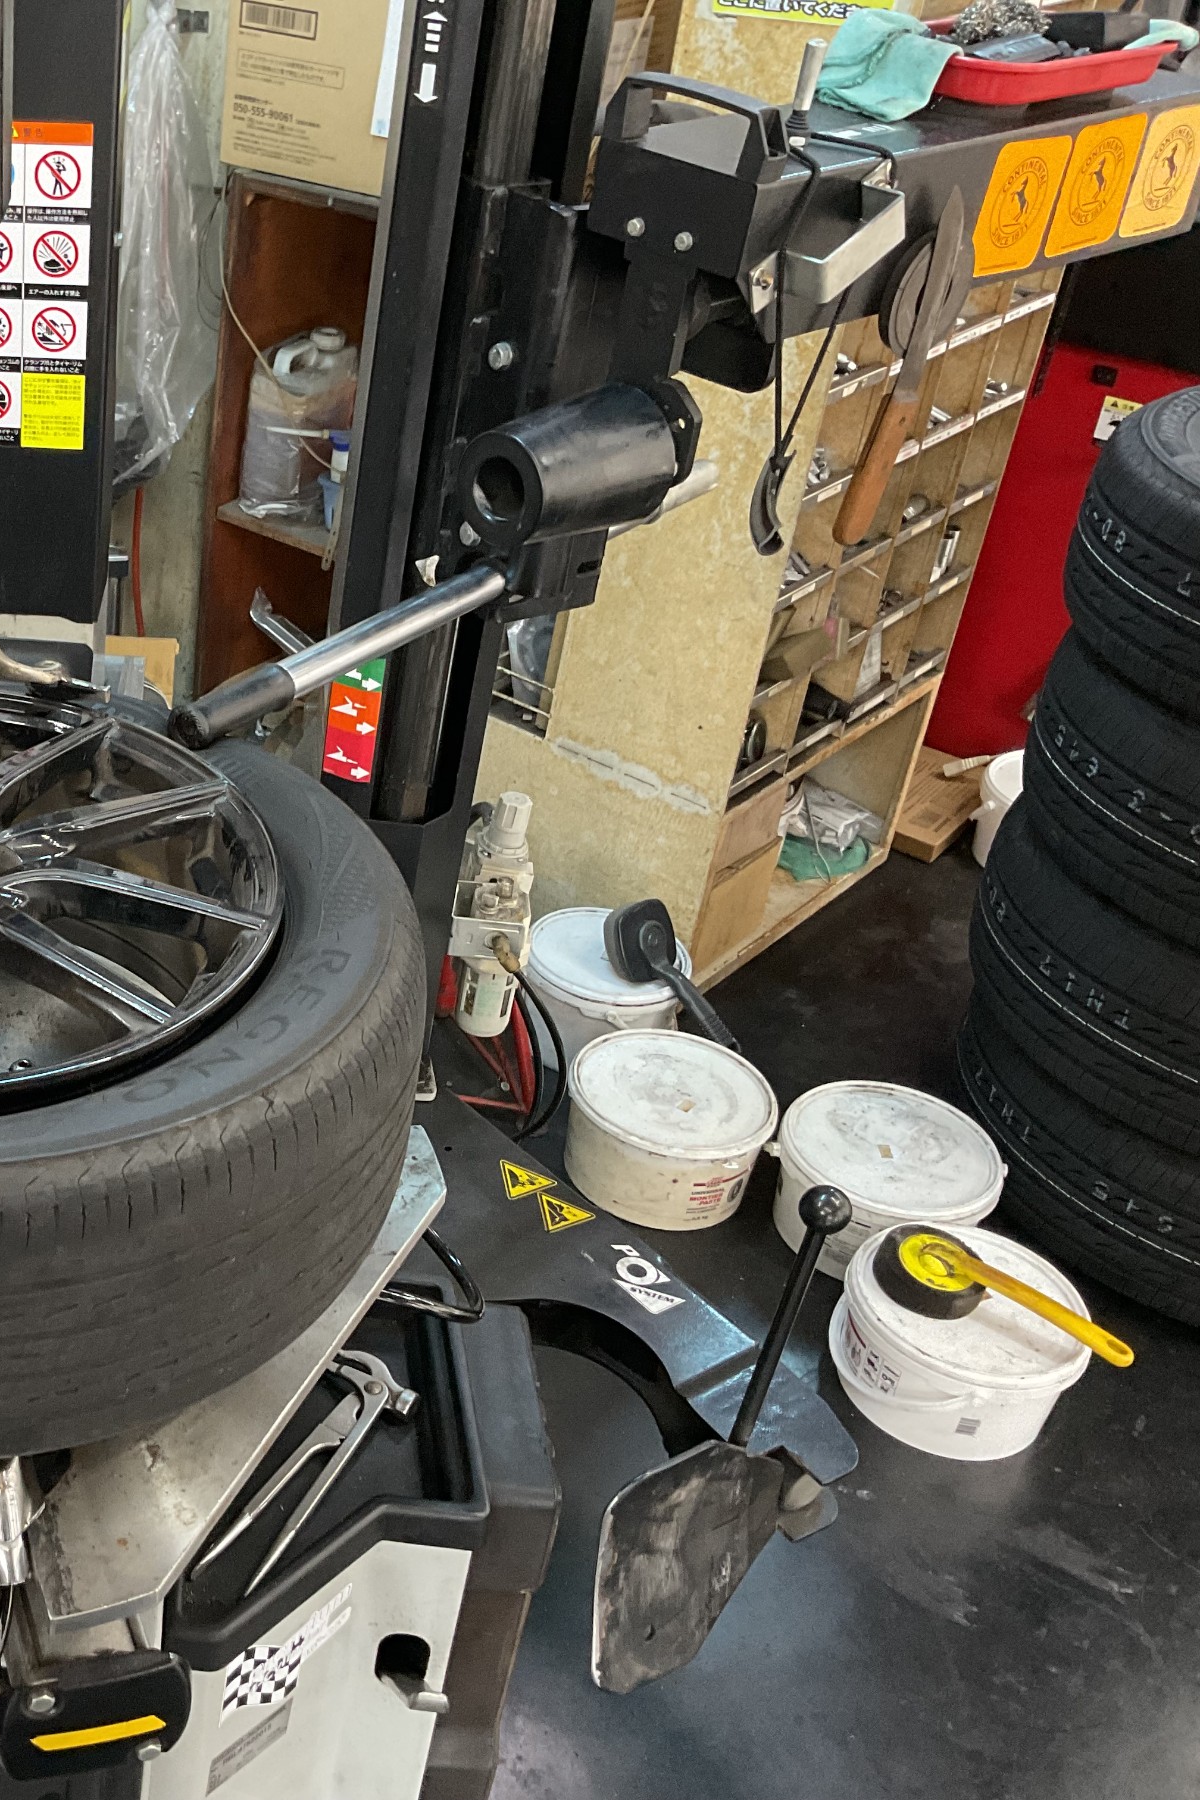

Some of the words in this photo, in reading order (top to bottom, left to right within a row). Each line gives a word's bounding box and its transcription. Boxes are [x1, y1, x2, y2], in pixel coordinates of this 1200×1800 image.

[1081, 136, 1125, 175] CONTINENTAL
[1152, 124, 1195, 161] CONTINENTAL
[1002, 157, 1048, 193] CONTINENTAL
[122, 949, 352, 1104] REGNO
[629, 1286, 675, 1304] SYSTEM
